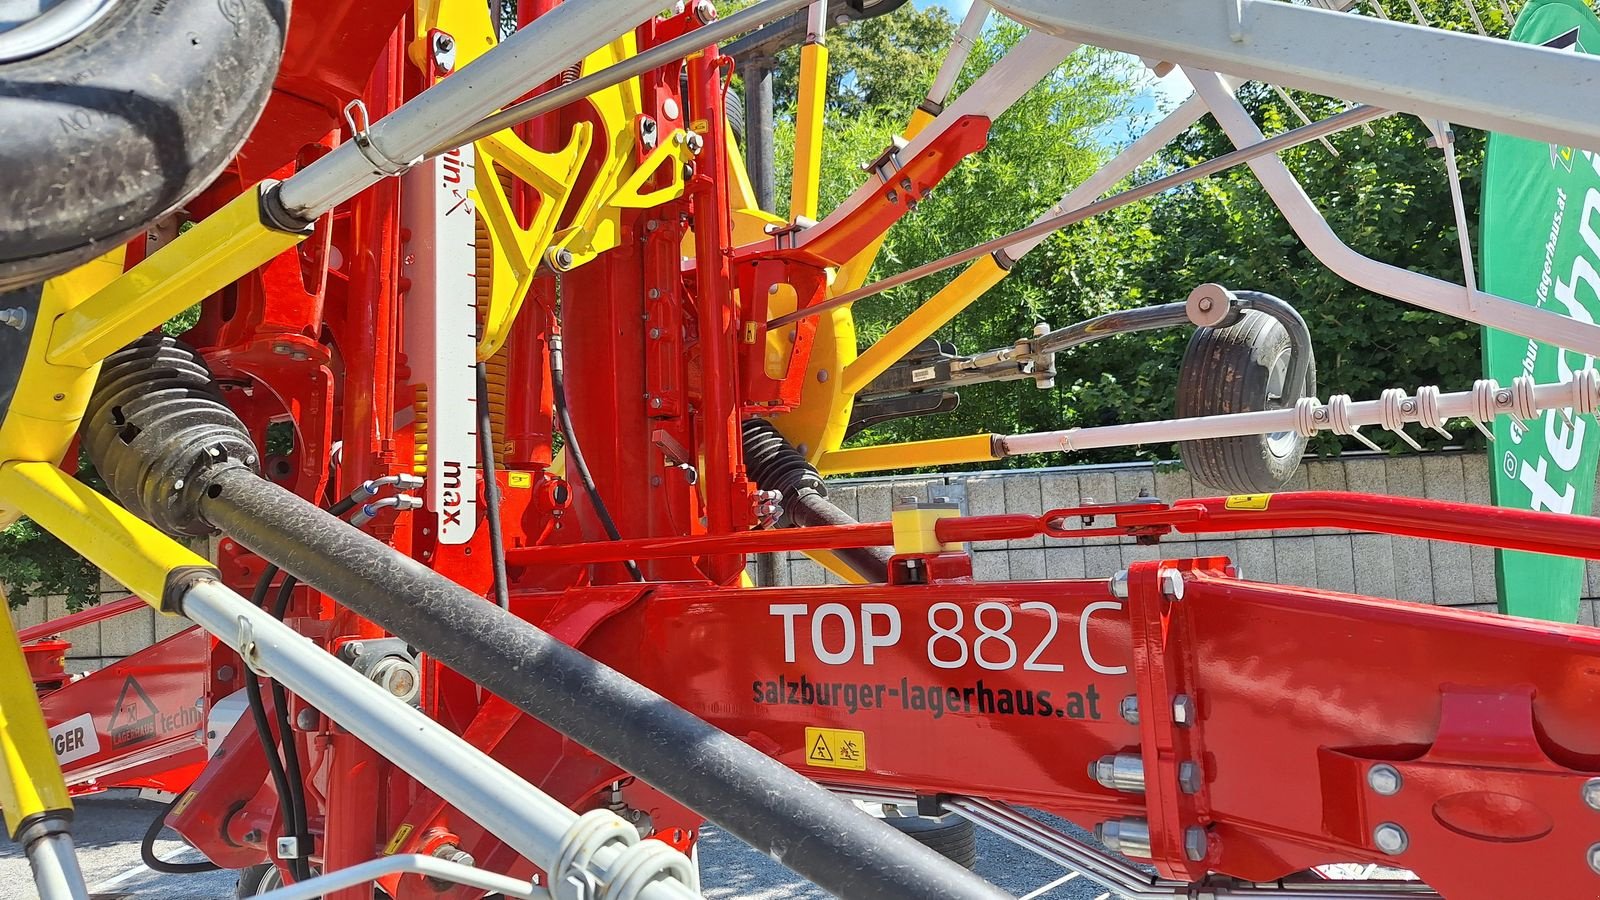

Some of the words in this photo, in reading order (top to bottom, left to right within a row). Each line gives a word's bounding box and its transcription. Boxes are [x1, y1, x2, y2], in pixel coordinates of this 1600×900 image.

[443, 461, 461, 534] max.
[769, 603, 902, 665] TOP
[927, 602, 1065, 672] 882
[1079, 602, 1128, 674] C
[752, 674, 1102, 720] salzburger-lagerhaus.at
[51, 726, 84, 756] GER
[113, 722, 155, 746] LAGERHAUS
